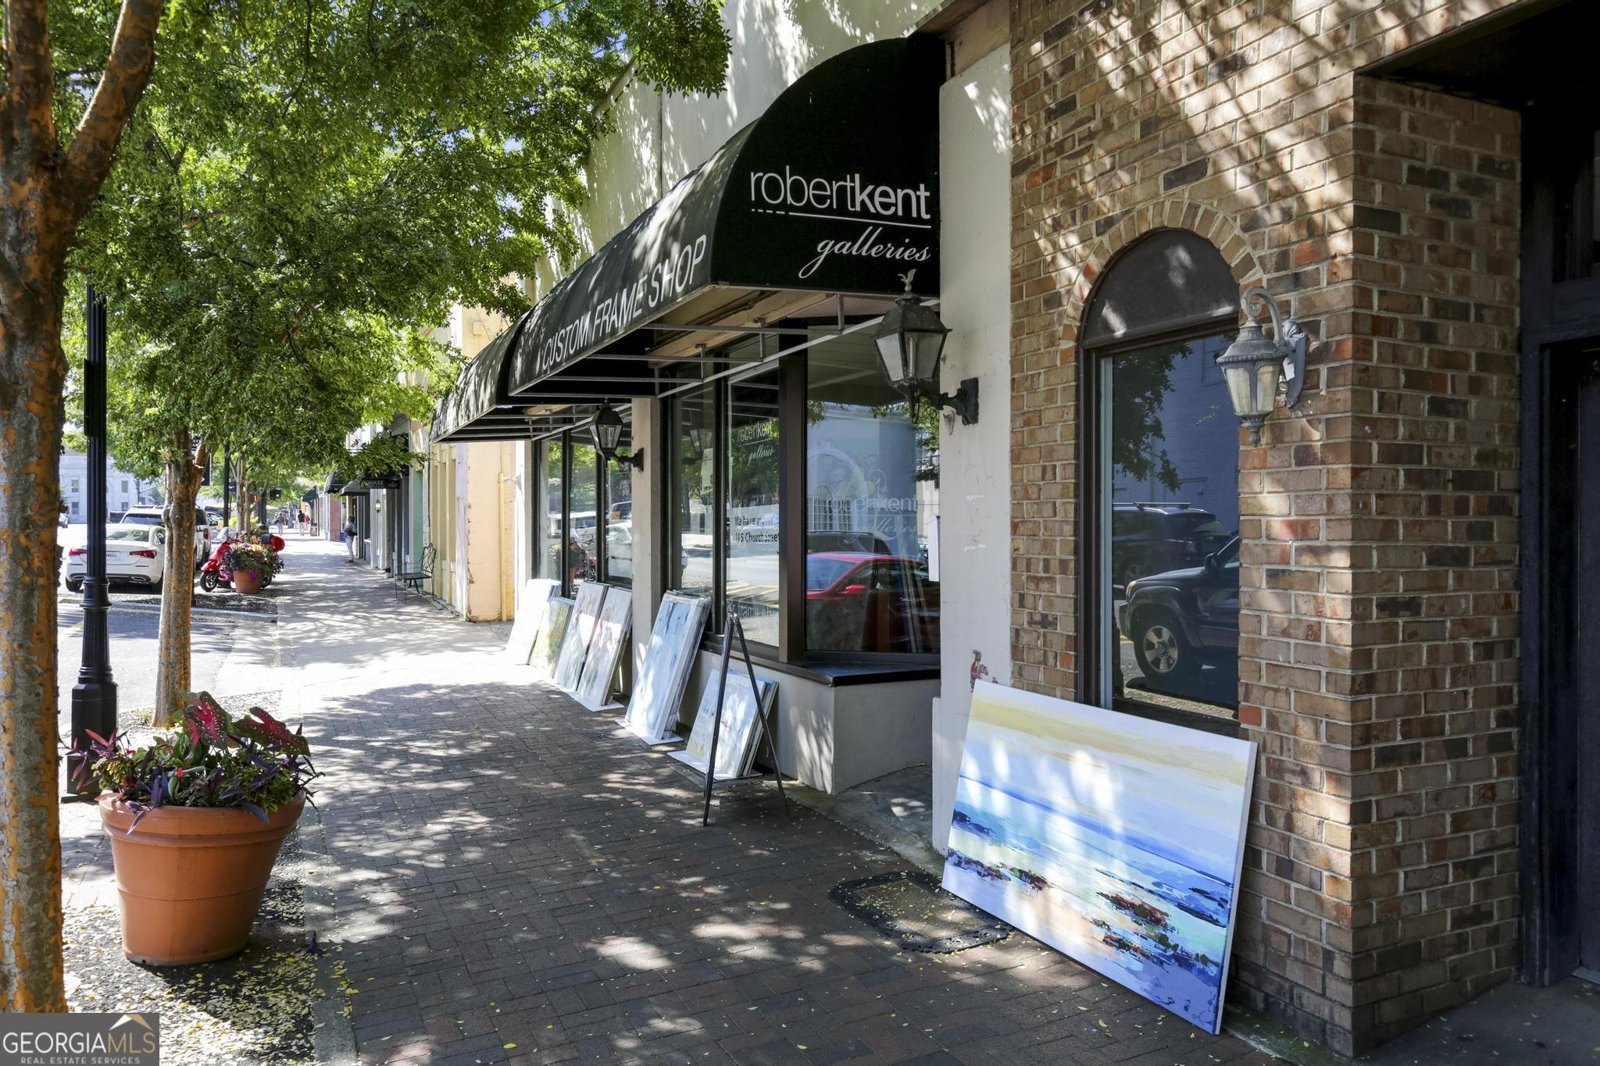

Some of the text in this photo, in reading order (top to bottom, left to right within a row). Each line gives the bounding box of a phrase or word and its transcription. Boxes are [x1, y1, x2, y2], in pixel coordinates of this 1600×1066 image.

[750, 165, 931, 219] robertkent
[798, 226, 931, 278] galleries
[542, 234, 707, 370] CUSTOM FRAME SHOP
